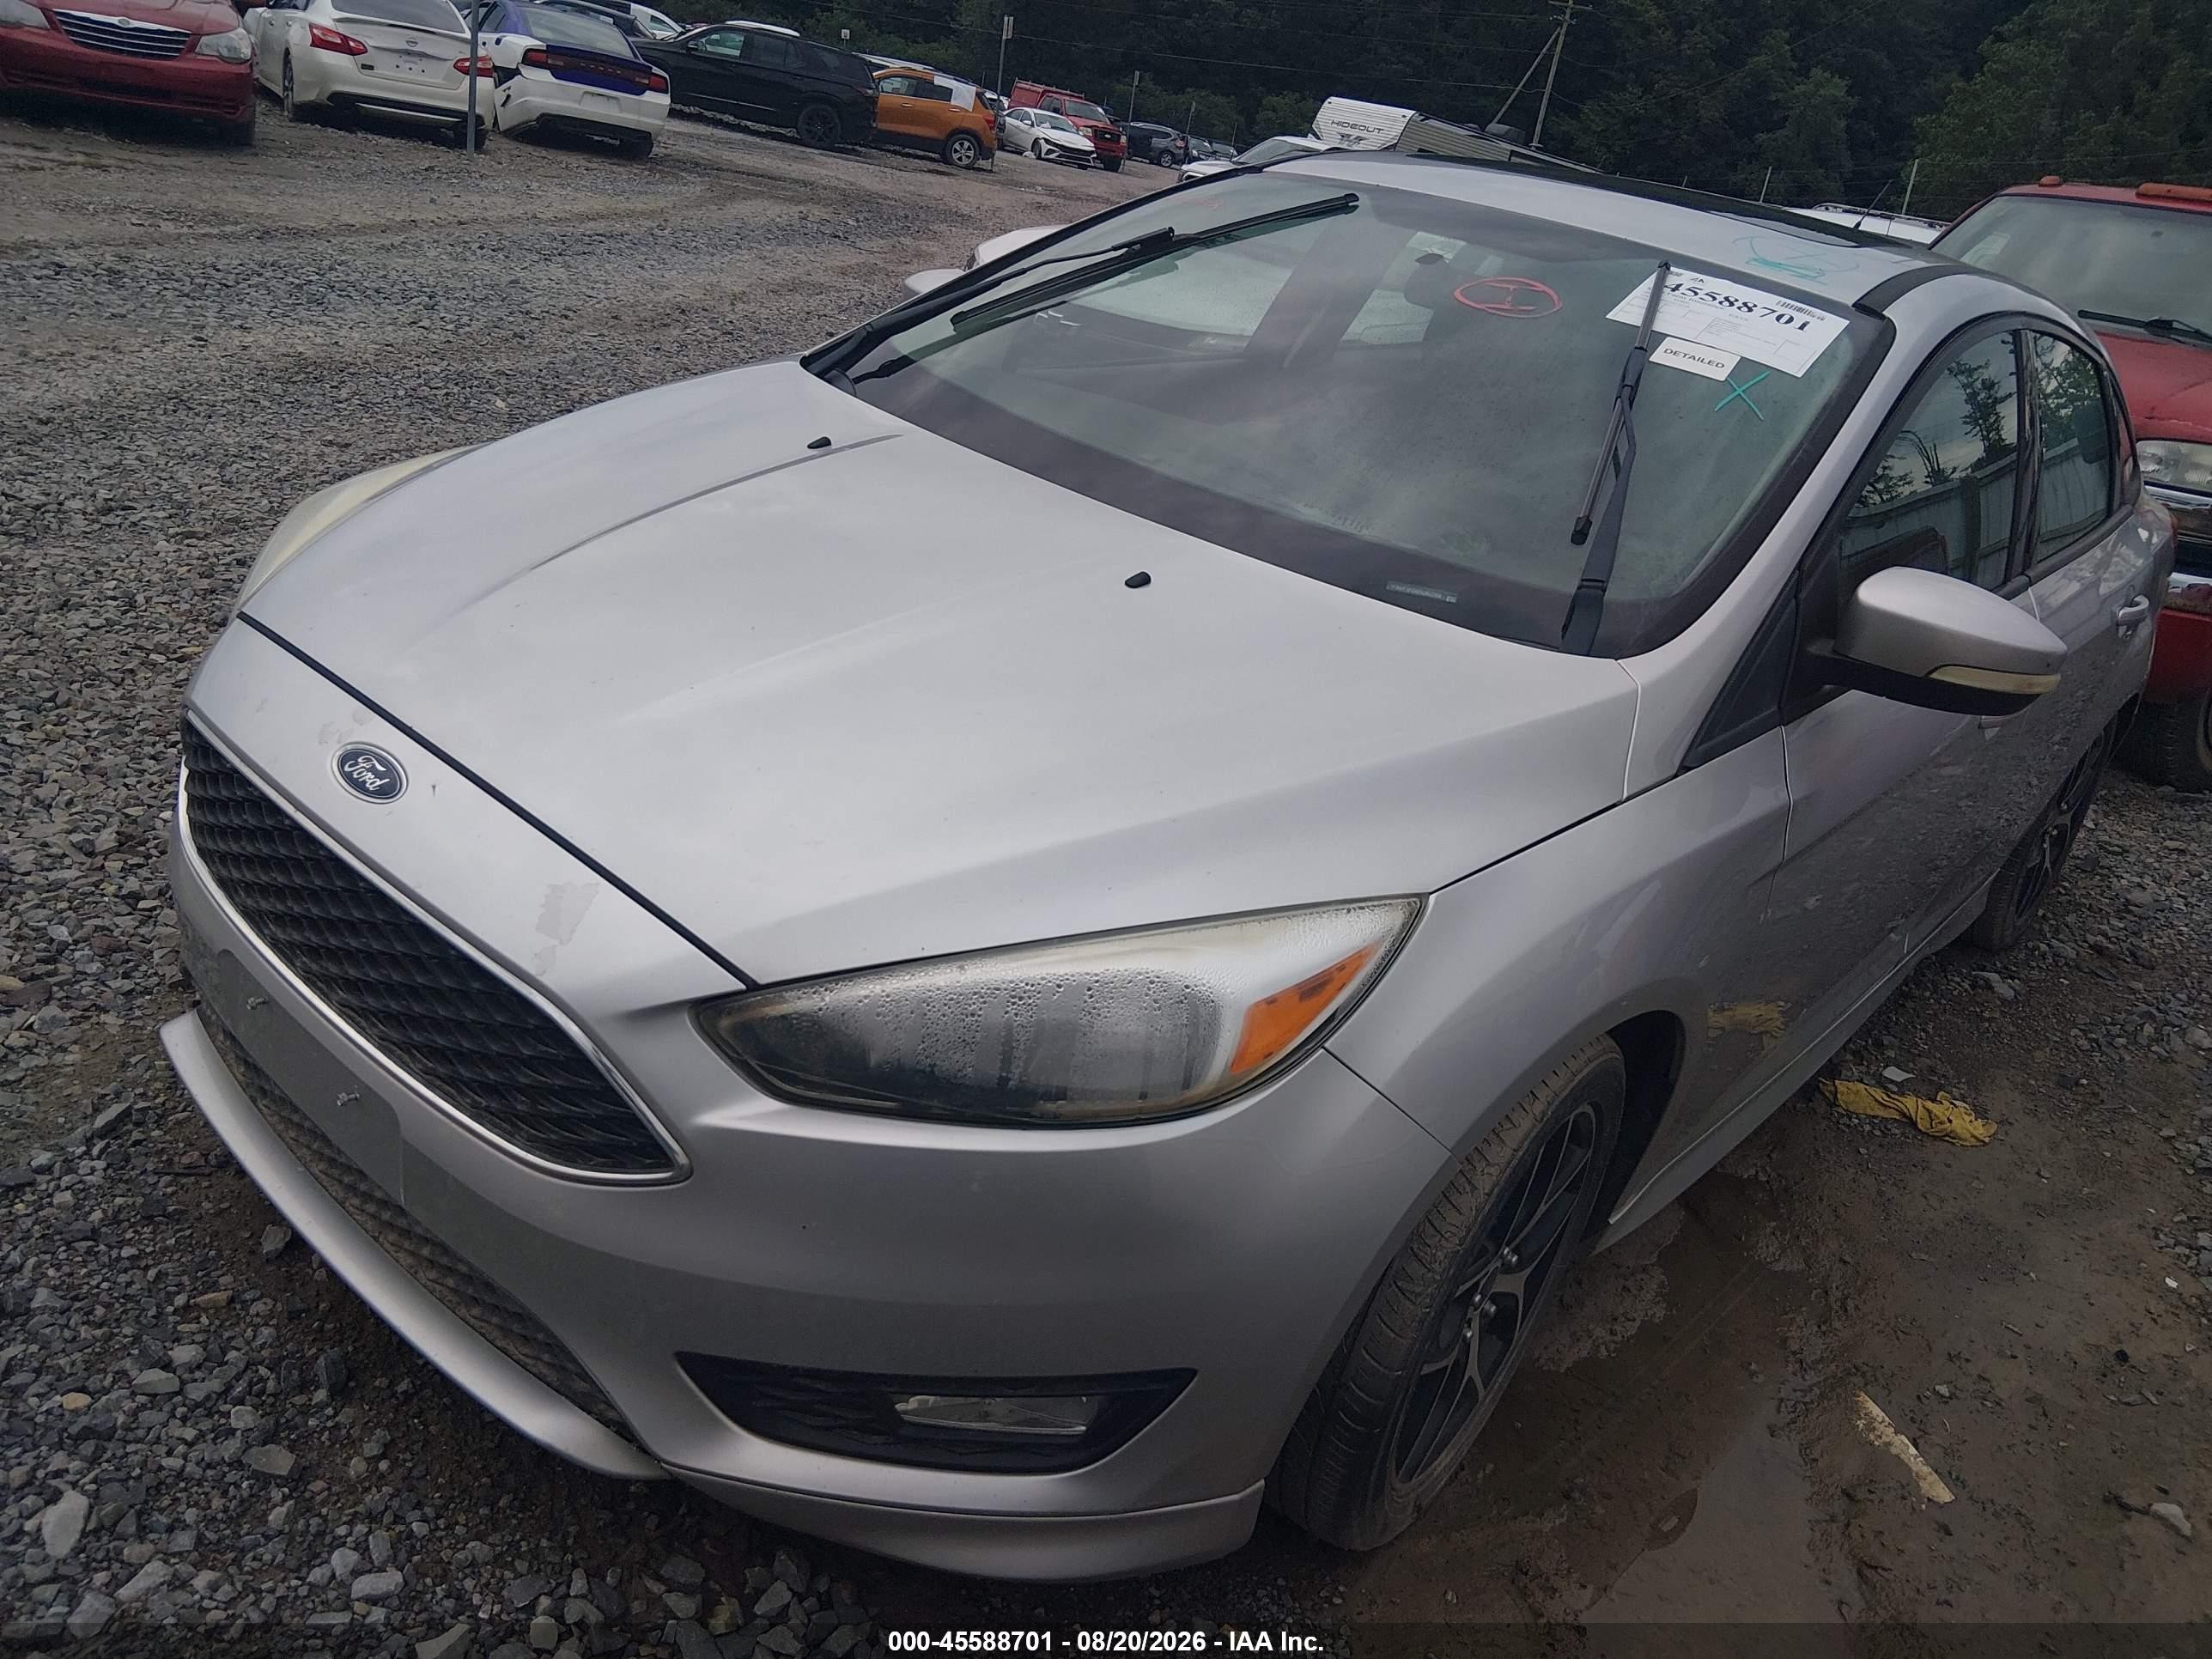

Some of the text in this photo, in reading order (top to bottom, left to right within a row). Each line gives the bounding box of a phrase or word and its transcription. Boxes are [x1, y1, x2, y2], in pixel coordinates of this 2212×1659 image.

[1330, 119, 1385, 134] HIDEOUT
[1663, 283, 1811, 331] 45588701
[1663, 347, 1726, 369] DETAILED
[343, 755, 391, 791] Ford
